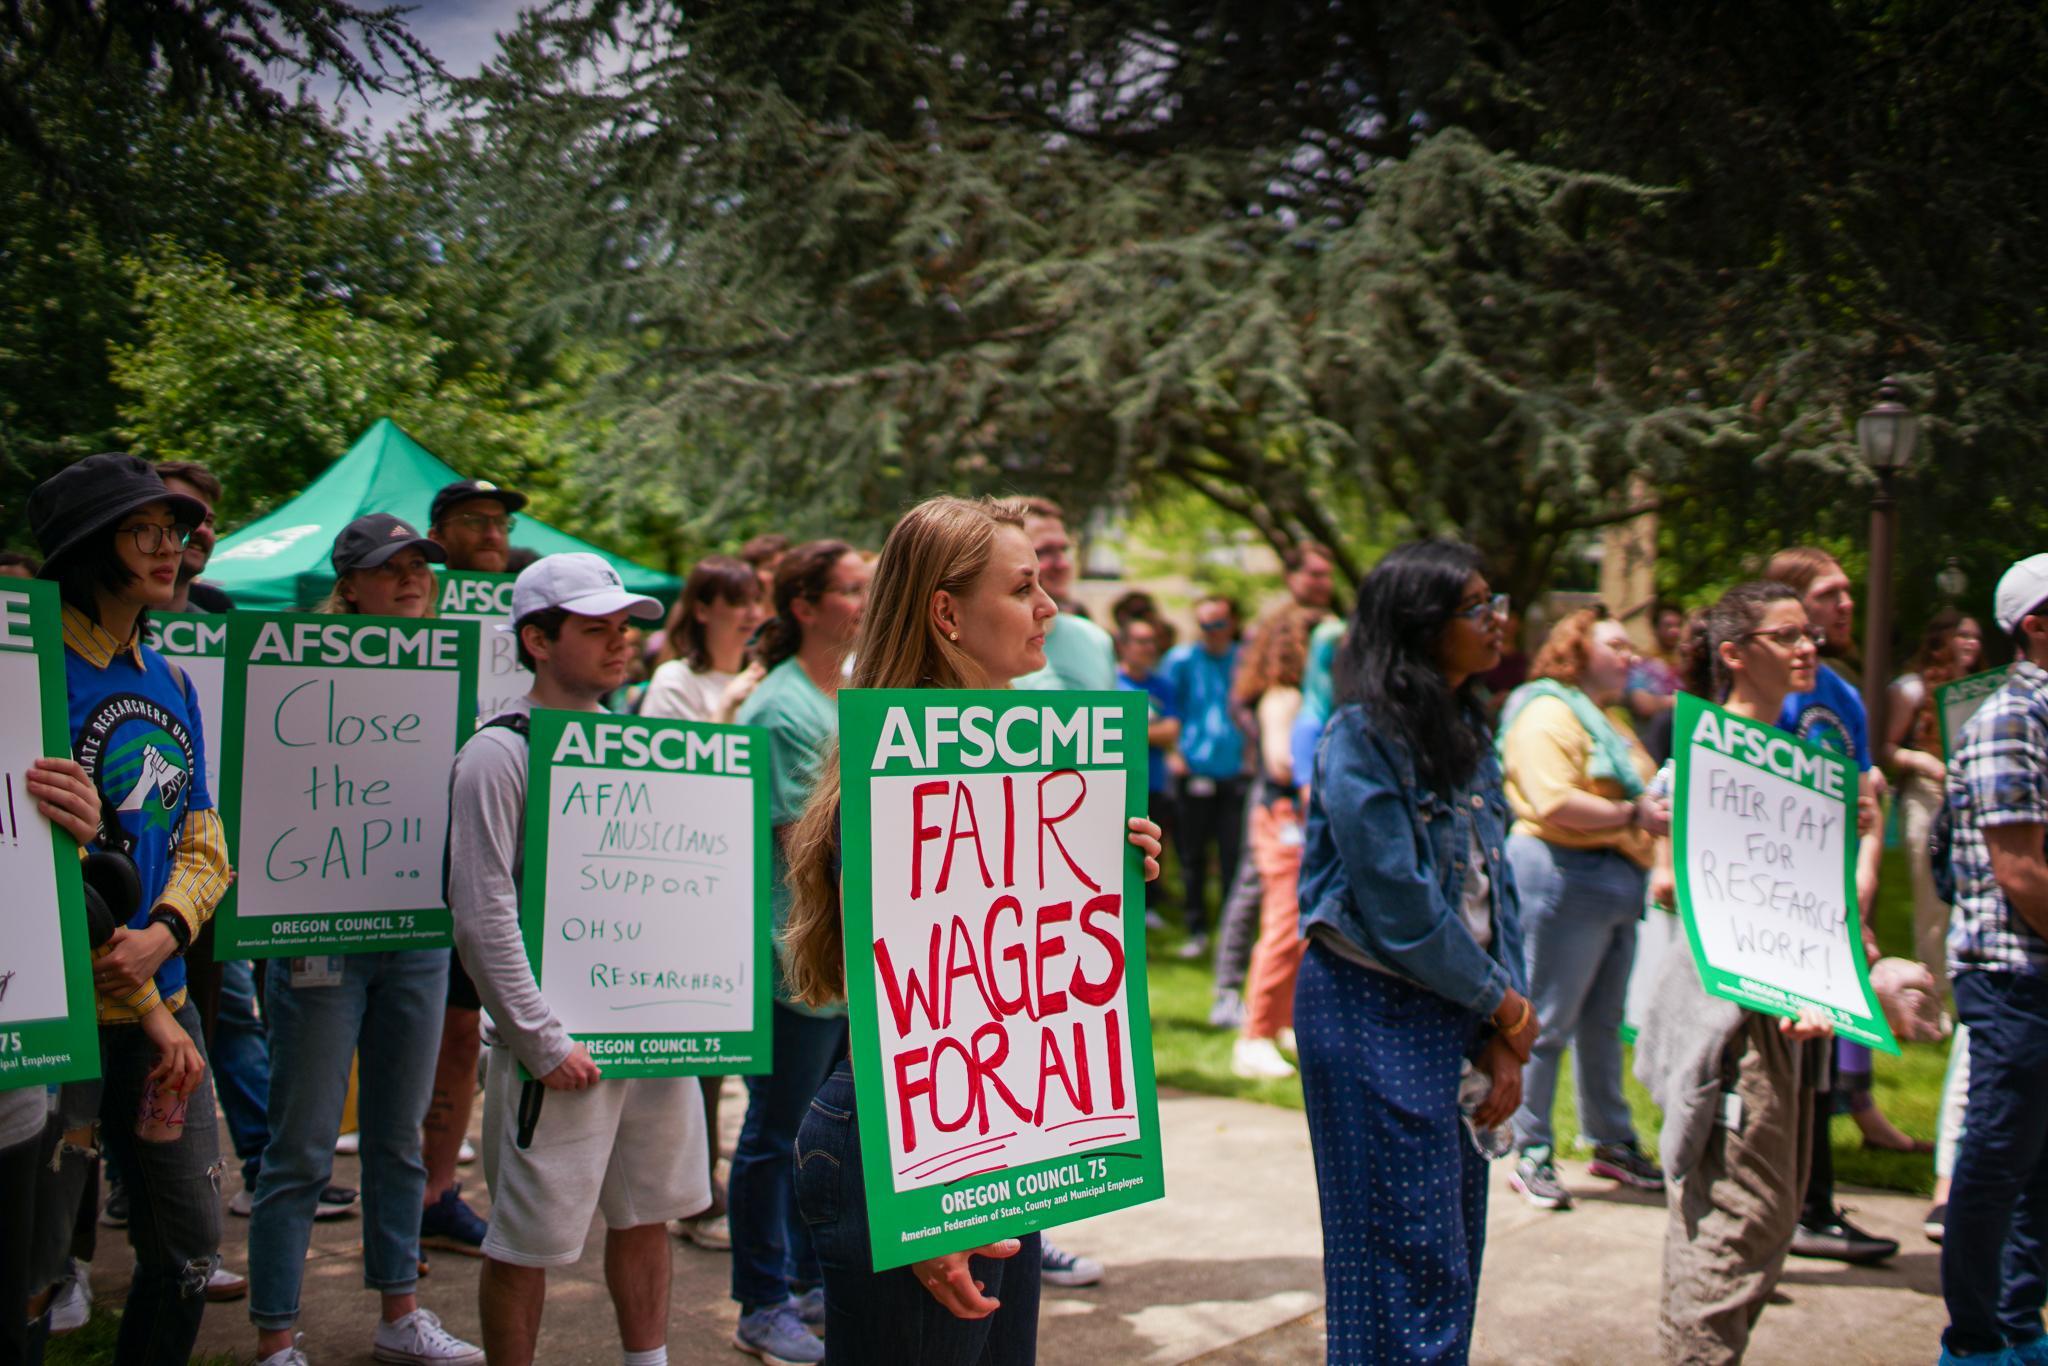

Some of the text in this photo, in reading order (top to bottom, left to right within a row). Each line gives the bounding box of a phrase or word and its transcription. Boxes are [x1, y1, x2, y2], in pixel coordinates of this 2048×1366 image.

[249, 622, 459, 667] AFSCME
[93, 700, 168, 734] RESEARCHERS
[173, 723, 194, 775] UNITED
[274, 679, 421, 748] Close
[870, 706, 1124, 770] AFSCME
[552, 721, 751, 774] AFSCME
[1691, 709, 1845, 799] AFSCME
[303, 764, 392, 811] the
[562, 781, 652, 817] AFM
[1709, 768, 1837, 851] FAIR PAY
[266, 817, 421, 882] GAP!!
[600, 819, 729, 856] MUSICIANS
[910, 768, 1101, 900] FAIR
[1745, 832, 1795, 871] FOR
[580, 864, 721, 897] SUPPORT
[1701, 849, 1849, 943] RESEARCH
[271, 915, 415, 935] OREGON COUNCIL 75
[561, 917, 643, 942] OHSU
[1731, 914, 1833, 991] WORK!
[873, 894, 1125, 1039] WAGES
[0, 1032, 22, 1053] 75
[21, 1053, 71, 1068] Employees
[586, 1037, 721, 1055] REGON COUNCIL 75
[893, 1021, 1034, 1154] FOR
[901, 1175, 1144, 1243] American Federation of State, County and Municipal Employees
[941, 1157, 1108, 1215] OREGON COUNCIL 75
